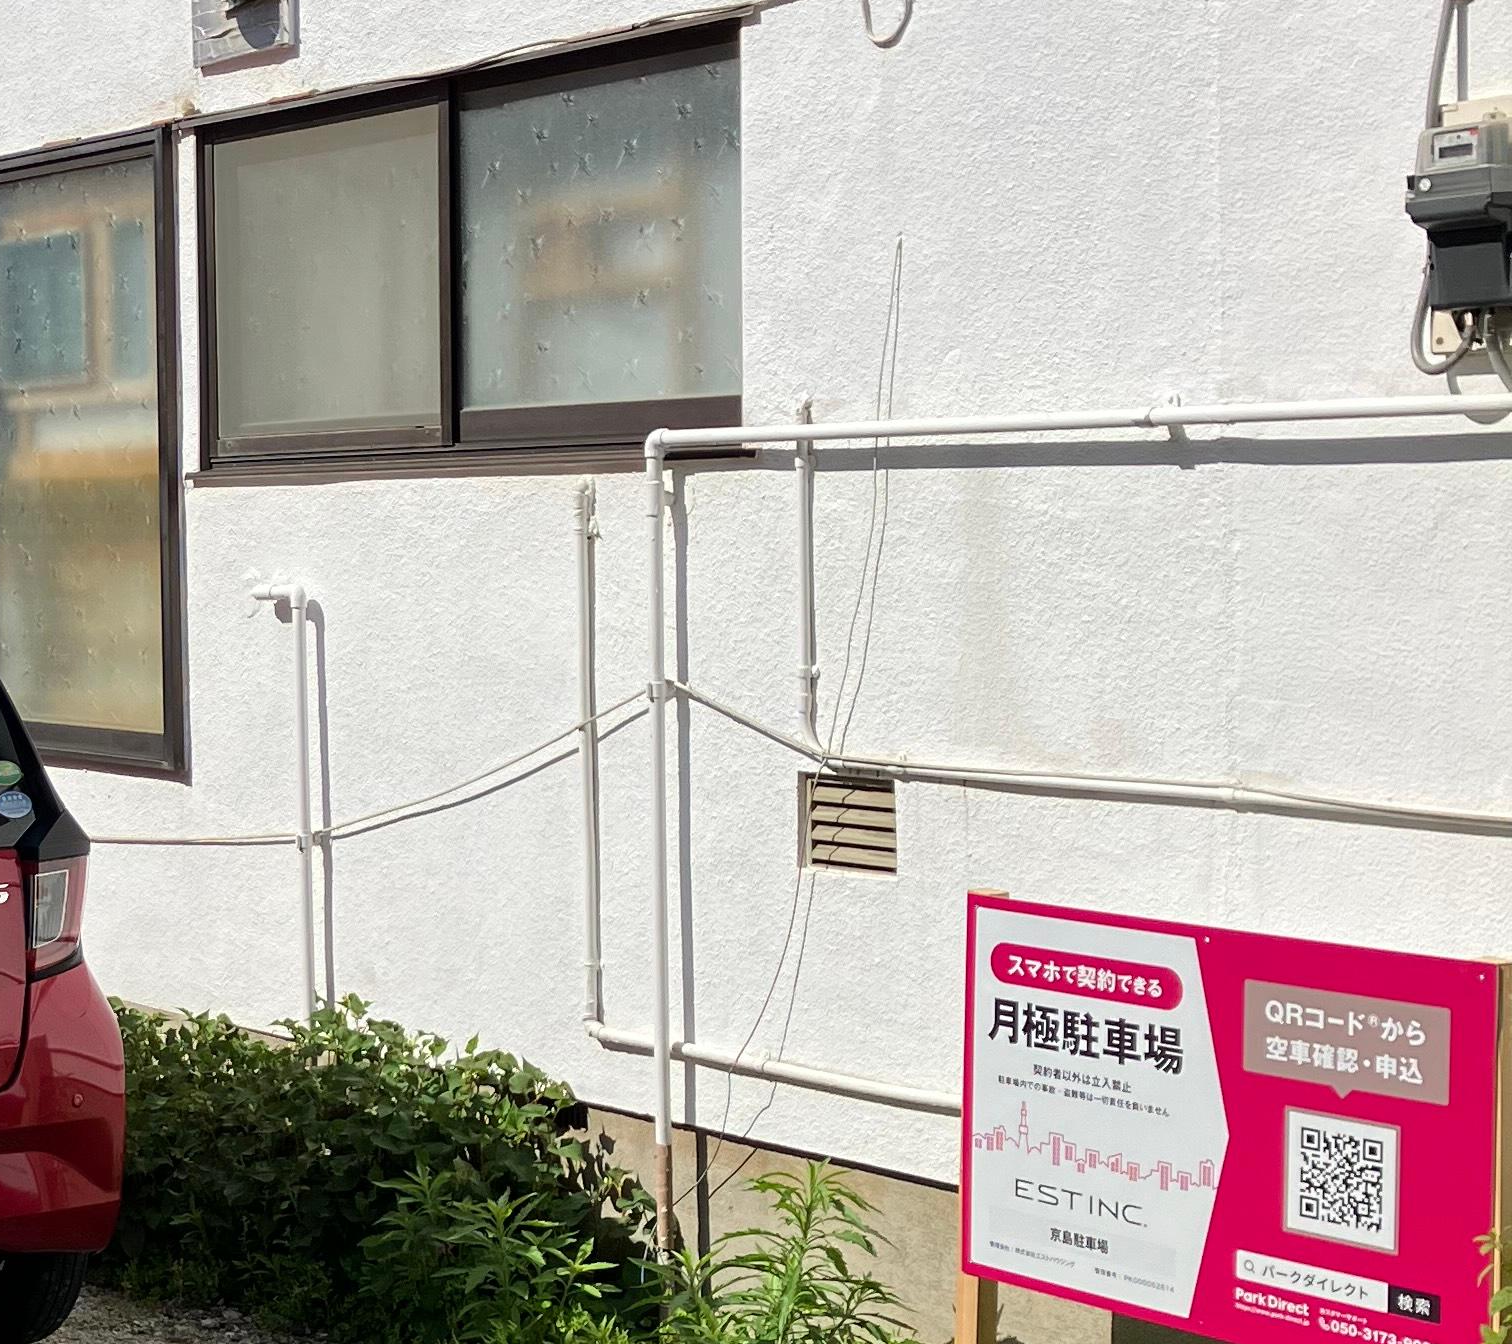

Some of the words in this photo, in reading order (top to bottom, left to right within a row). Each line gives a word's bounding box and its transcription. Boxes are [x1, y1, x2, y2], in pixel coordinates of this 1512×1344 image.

[1007, 954, 1163, 999] スマホで契約できる
[988, 997, 1184, 1075] 月極駐車場
[1032, 1063, 1133, 1094] 契約者以外は立入禁止
[1265, 1035, 1424, 1086] 空車確認・申込
[1015, 1178, 1083, 1210] EST
[1049, 1227, 1110, 1255] 京島駐車場
[1262, 1264, 1369, 1301] パークダイレクト
[1397, 1293, 1432, 1317] 検索
